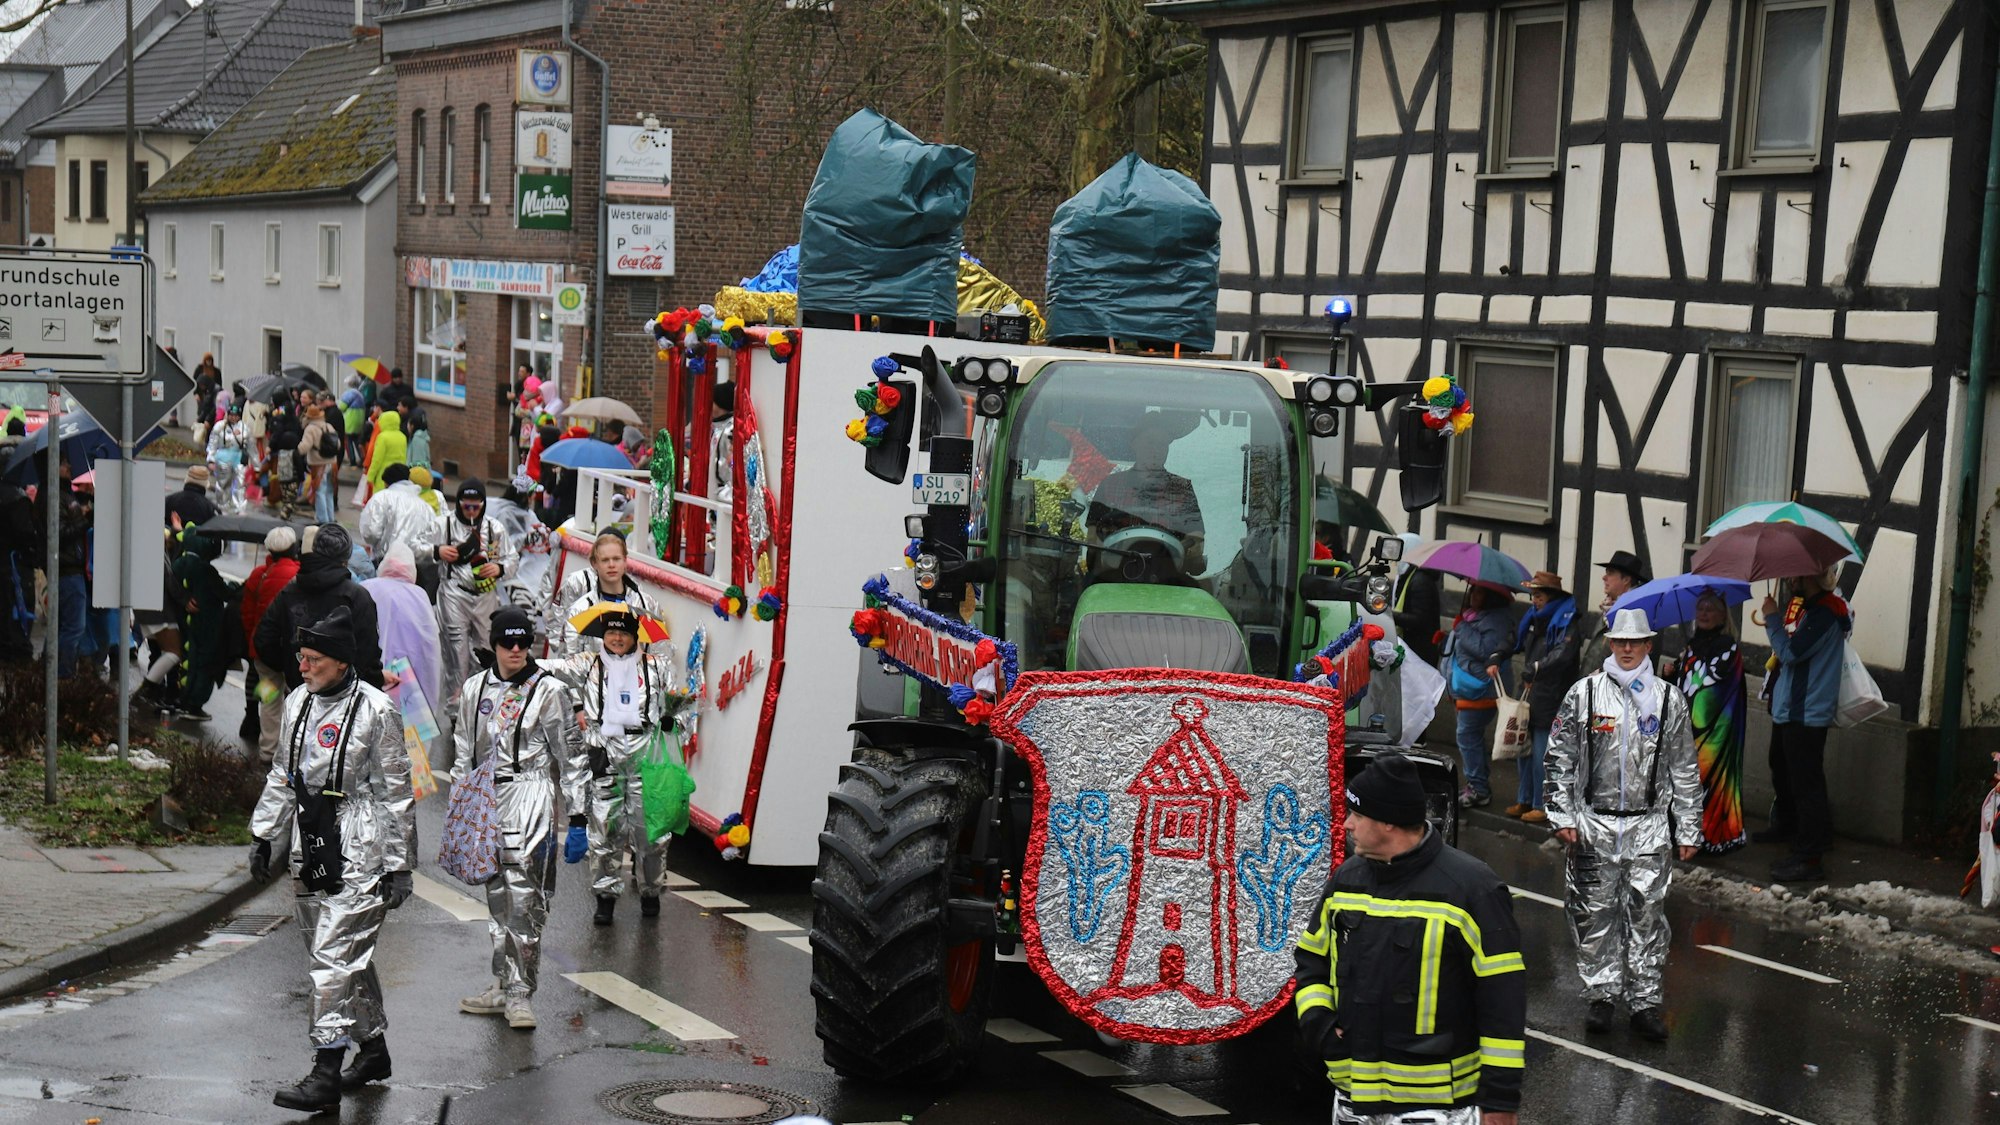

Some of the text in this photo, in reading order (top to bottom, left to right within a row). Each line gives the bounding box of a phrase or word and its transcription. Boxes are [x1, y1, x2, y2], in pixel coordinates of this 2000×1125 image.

[521, 185, 570, 218] Mythos
[611, 208, 672, 221] Westerwald-
[631, 224, 651, 235] Grill
[1, 267, 120, 287] rundschule
[516, 263, 543, 283] GRILL
[501, 282, 541, 294] HAMBURGER
[0, 292, 124, 314] portanlagen
[926, 475, 943, 489] SU
[921, 490, 960, 504] V 219
[504, 627, 527, 636] NASA
